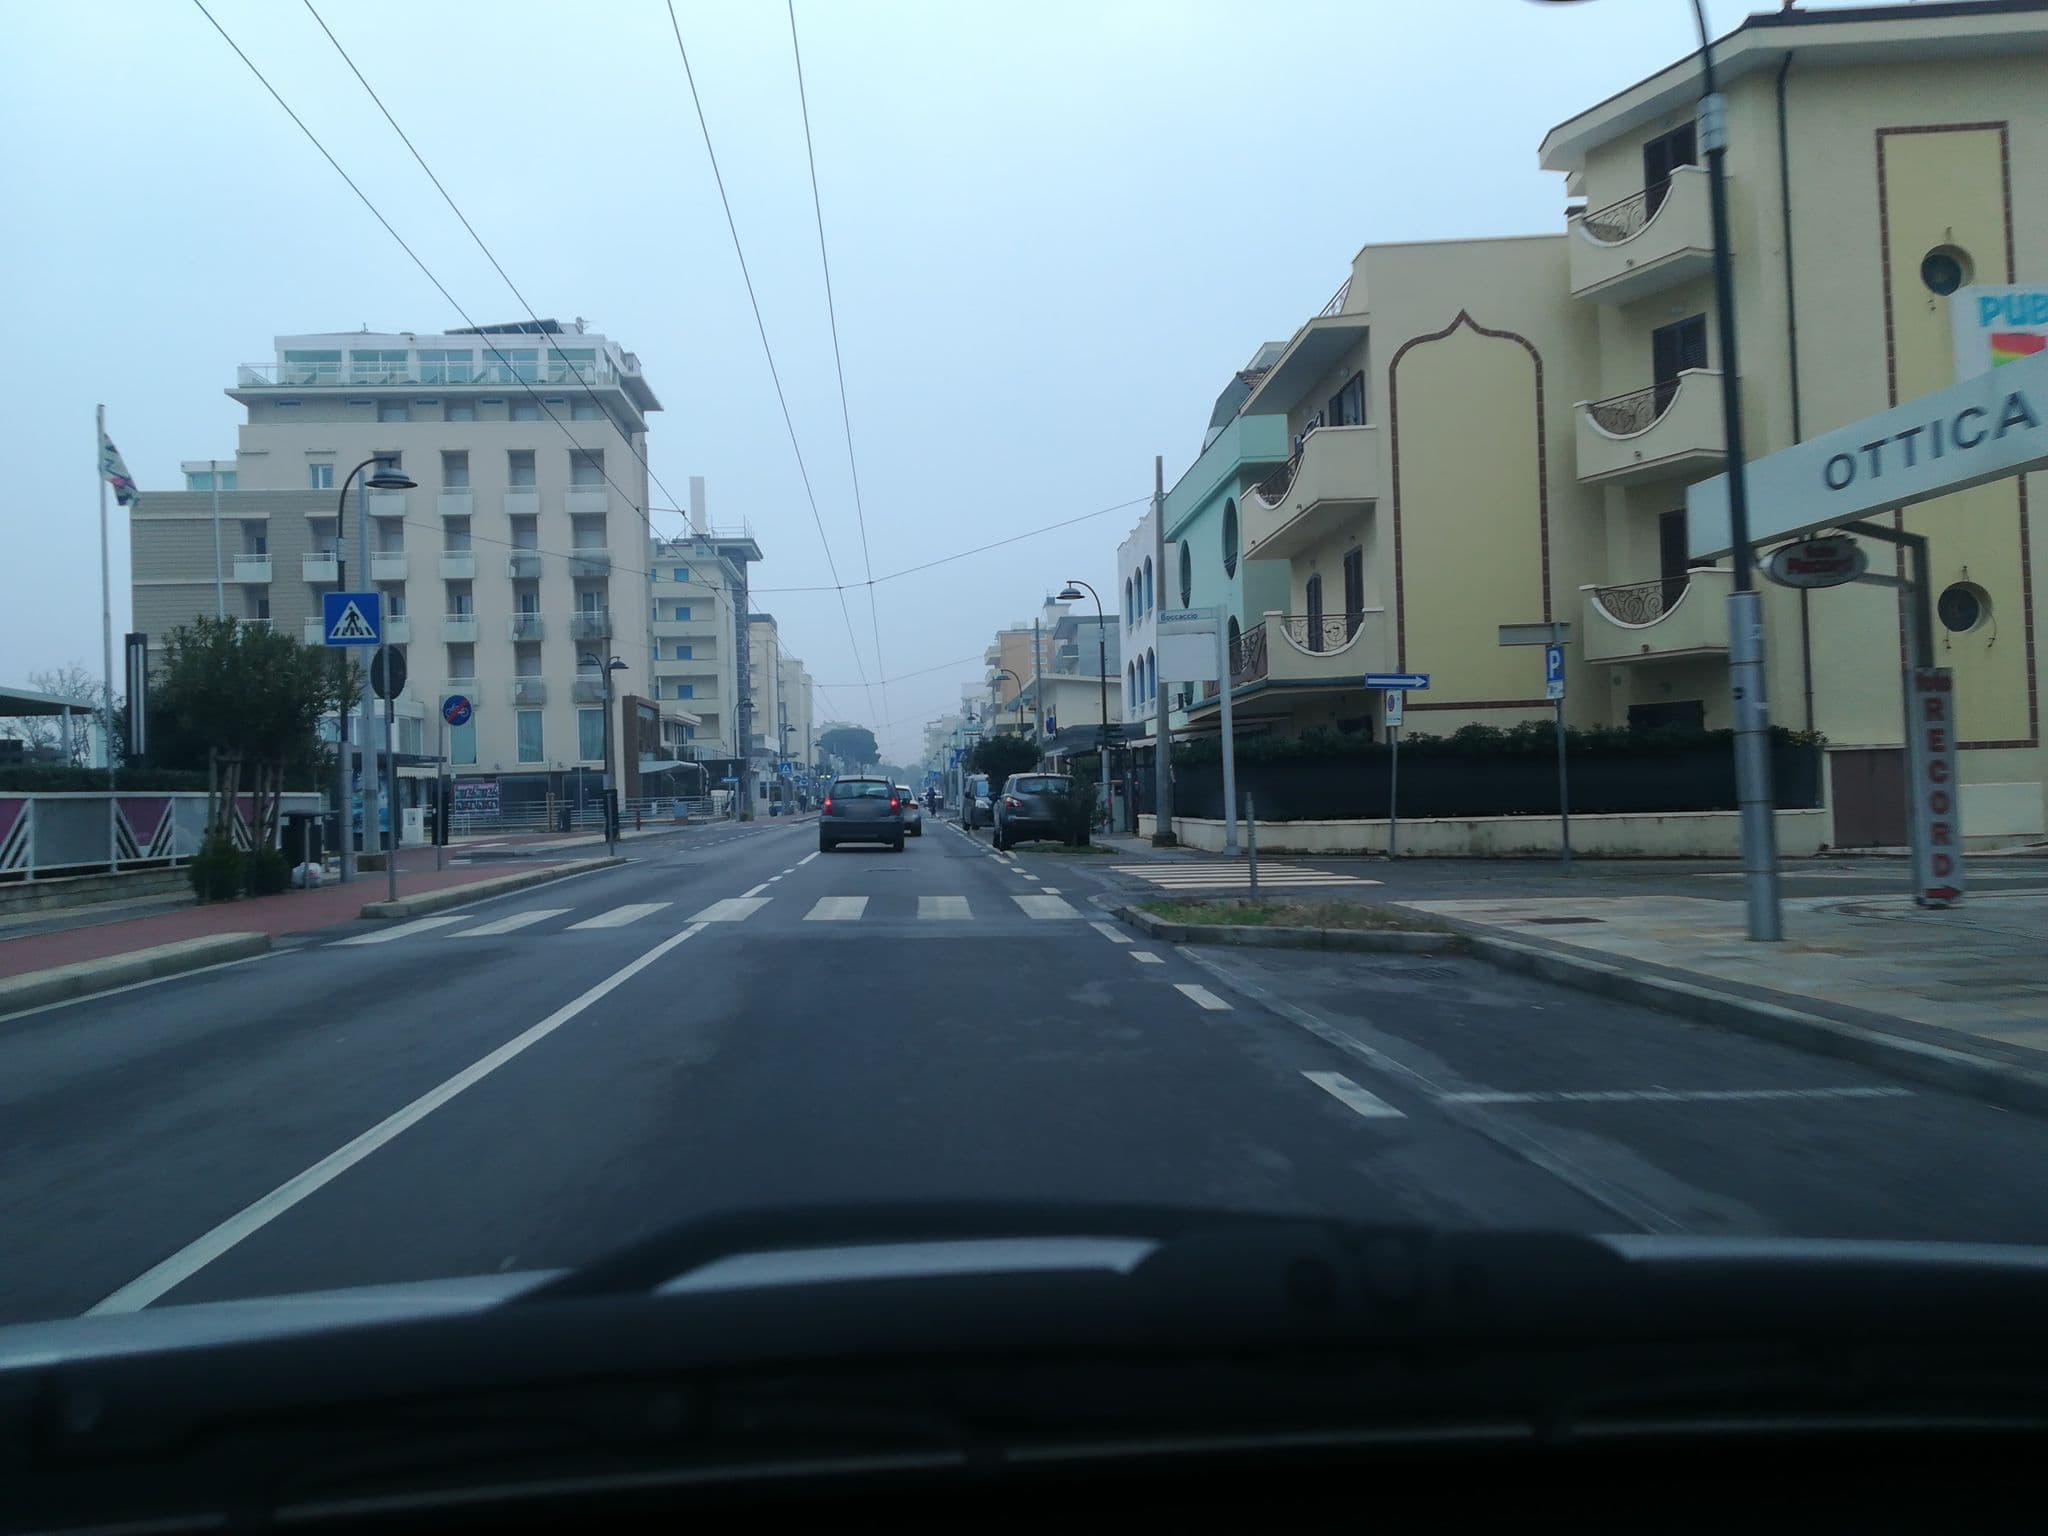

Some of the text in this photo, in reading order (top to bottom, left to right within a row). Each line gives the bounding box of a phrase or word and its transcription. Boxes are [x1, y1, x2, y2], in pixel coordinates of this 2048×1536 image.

[1823, 391, 2041, 491] OTTICA
[1549, 650, 1561, 679] P
[1924, 697, 1954, 878] RECORD
